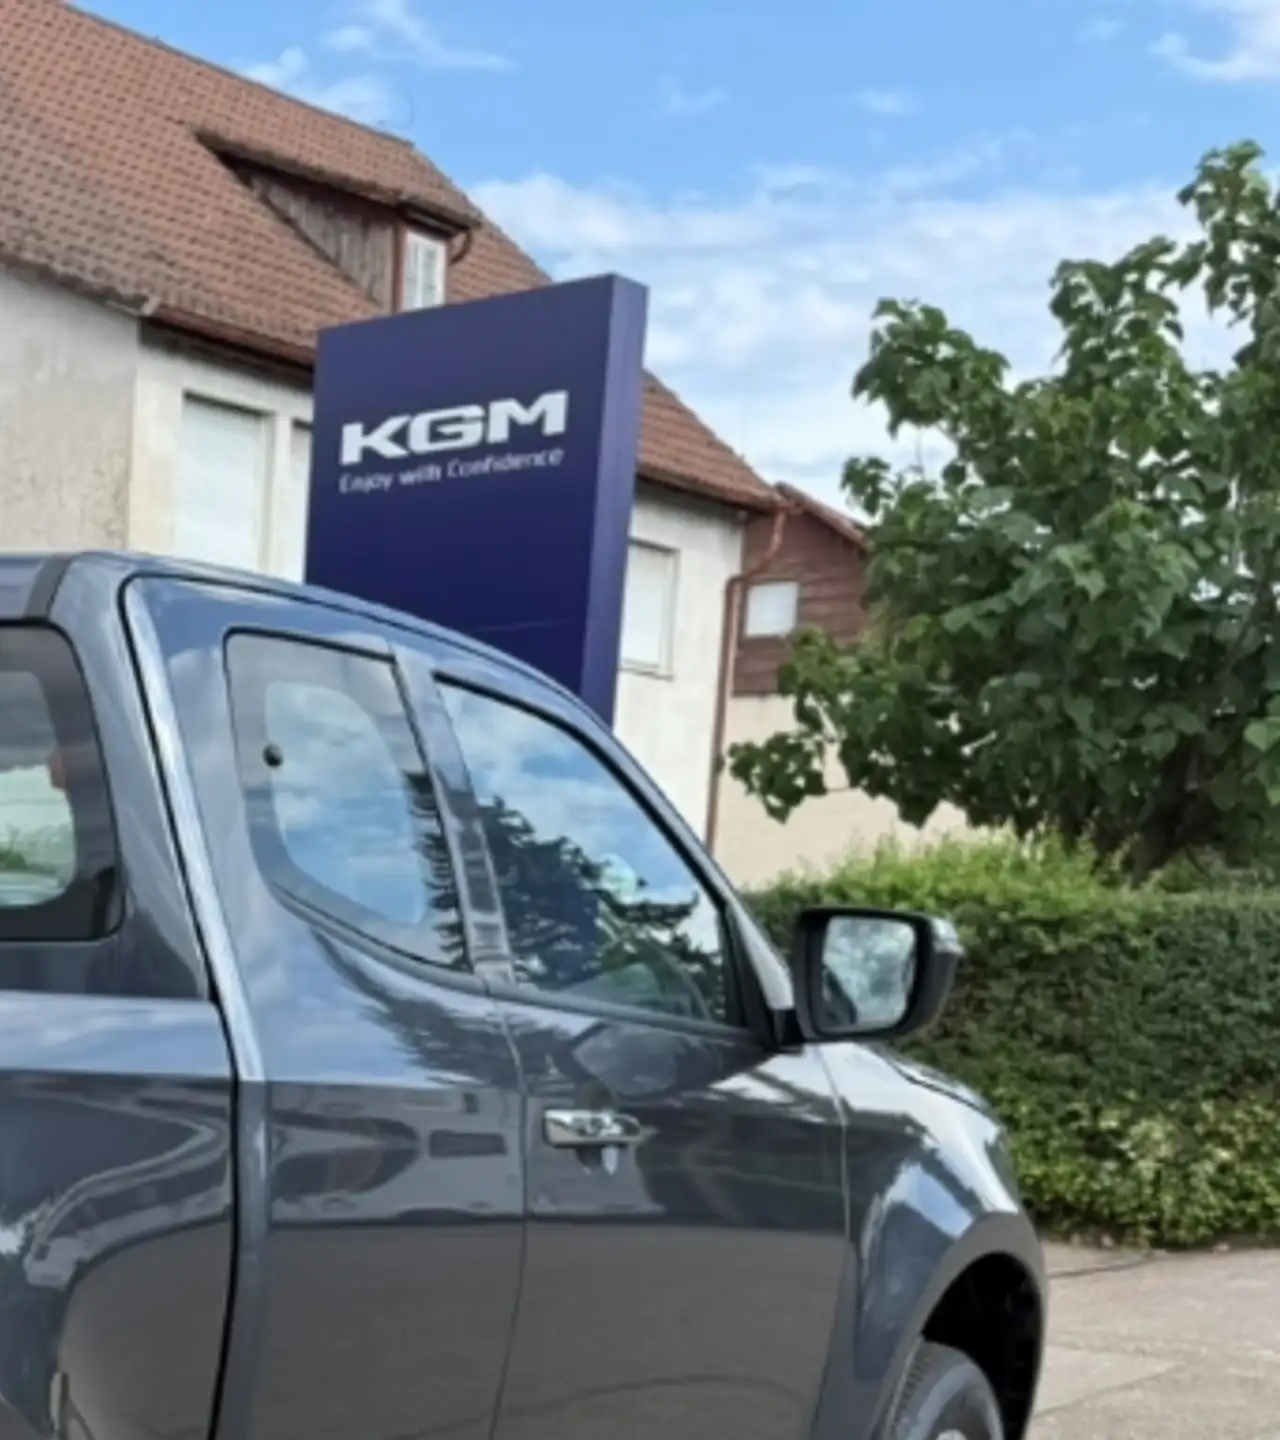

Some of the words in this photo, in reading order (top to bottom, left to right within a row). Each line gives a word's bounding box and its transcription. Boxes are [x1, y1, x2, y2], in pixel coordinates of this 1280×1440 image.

[340, 390, 568, 465] KGM
[339, 472, 394, 494] Enjoy
[398, 464, 440, 485] with
[446, 448, 565, 479] Confidence
